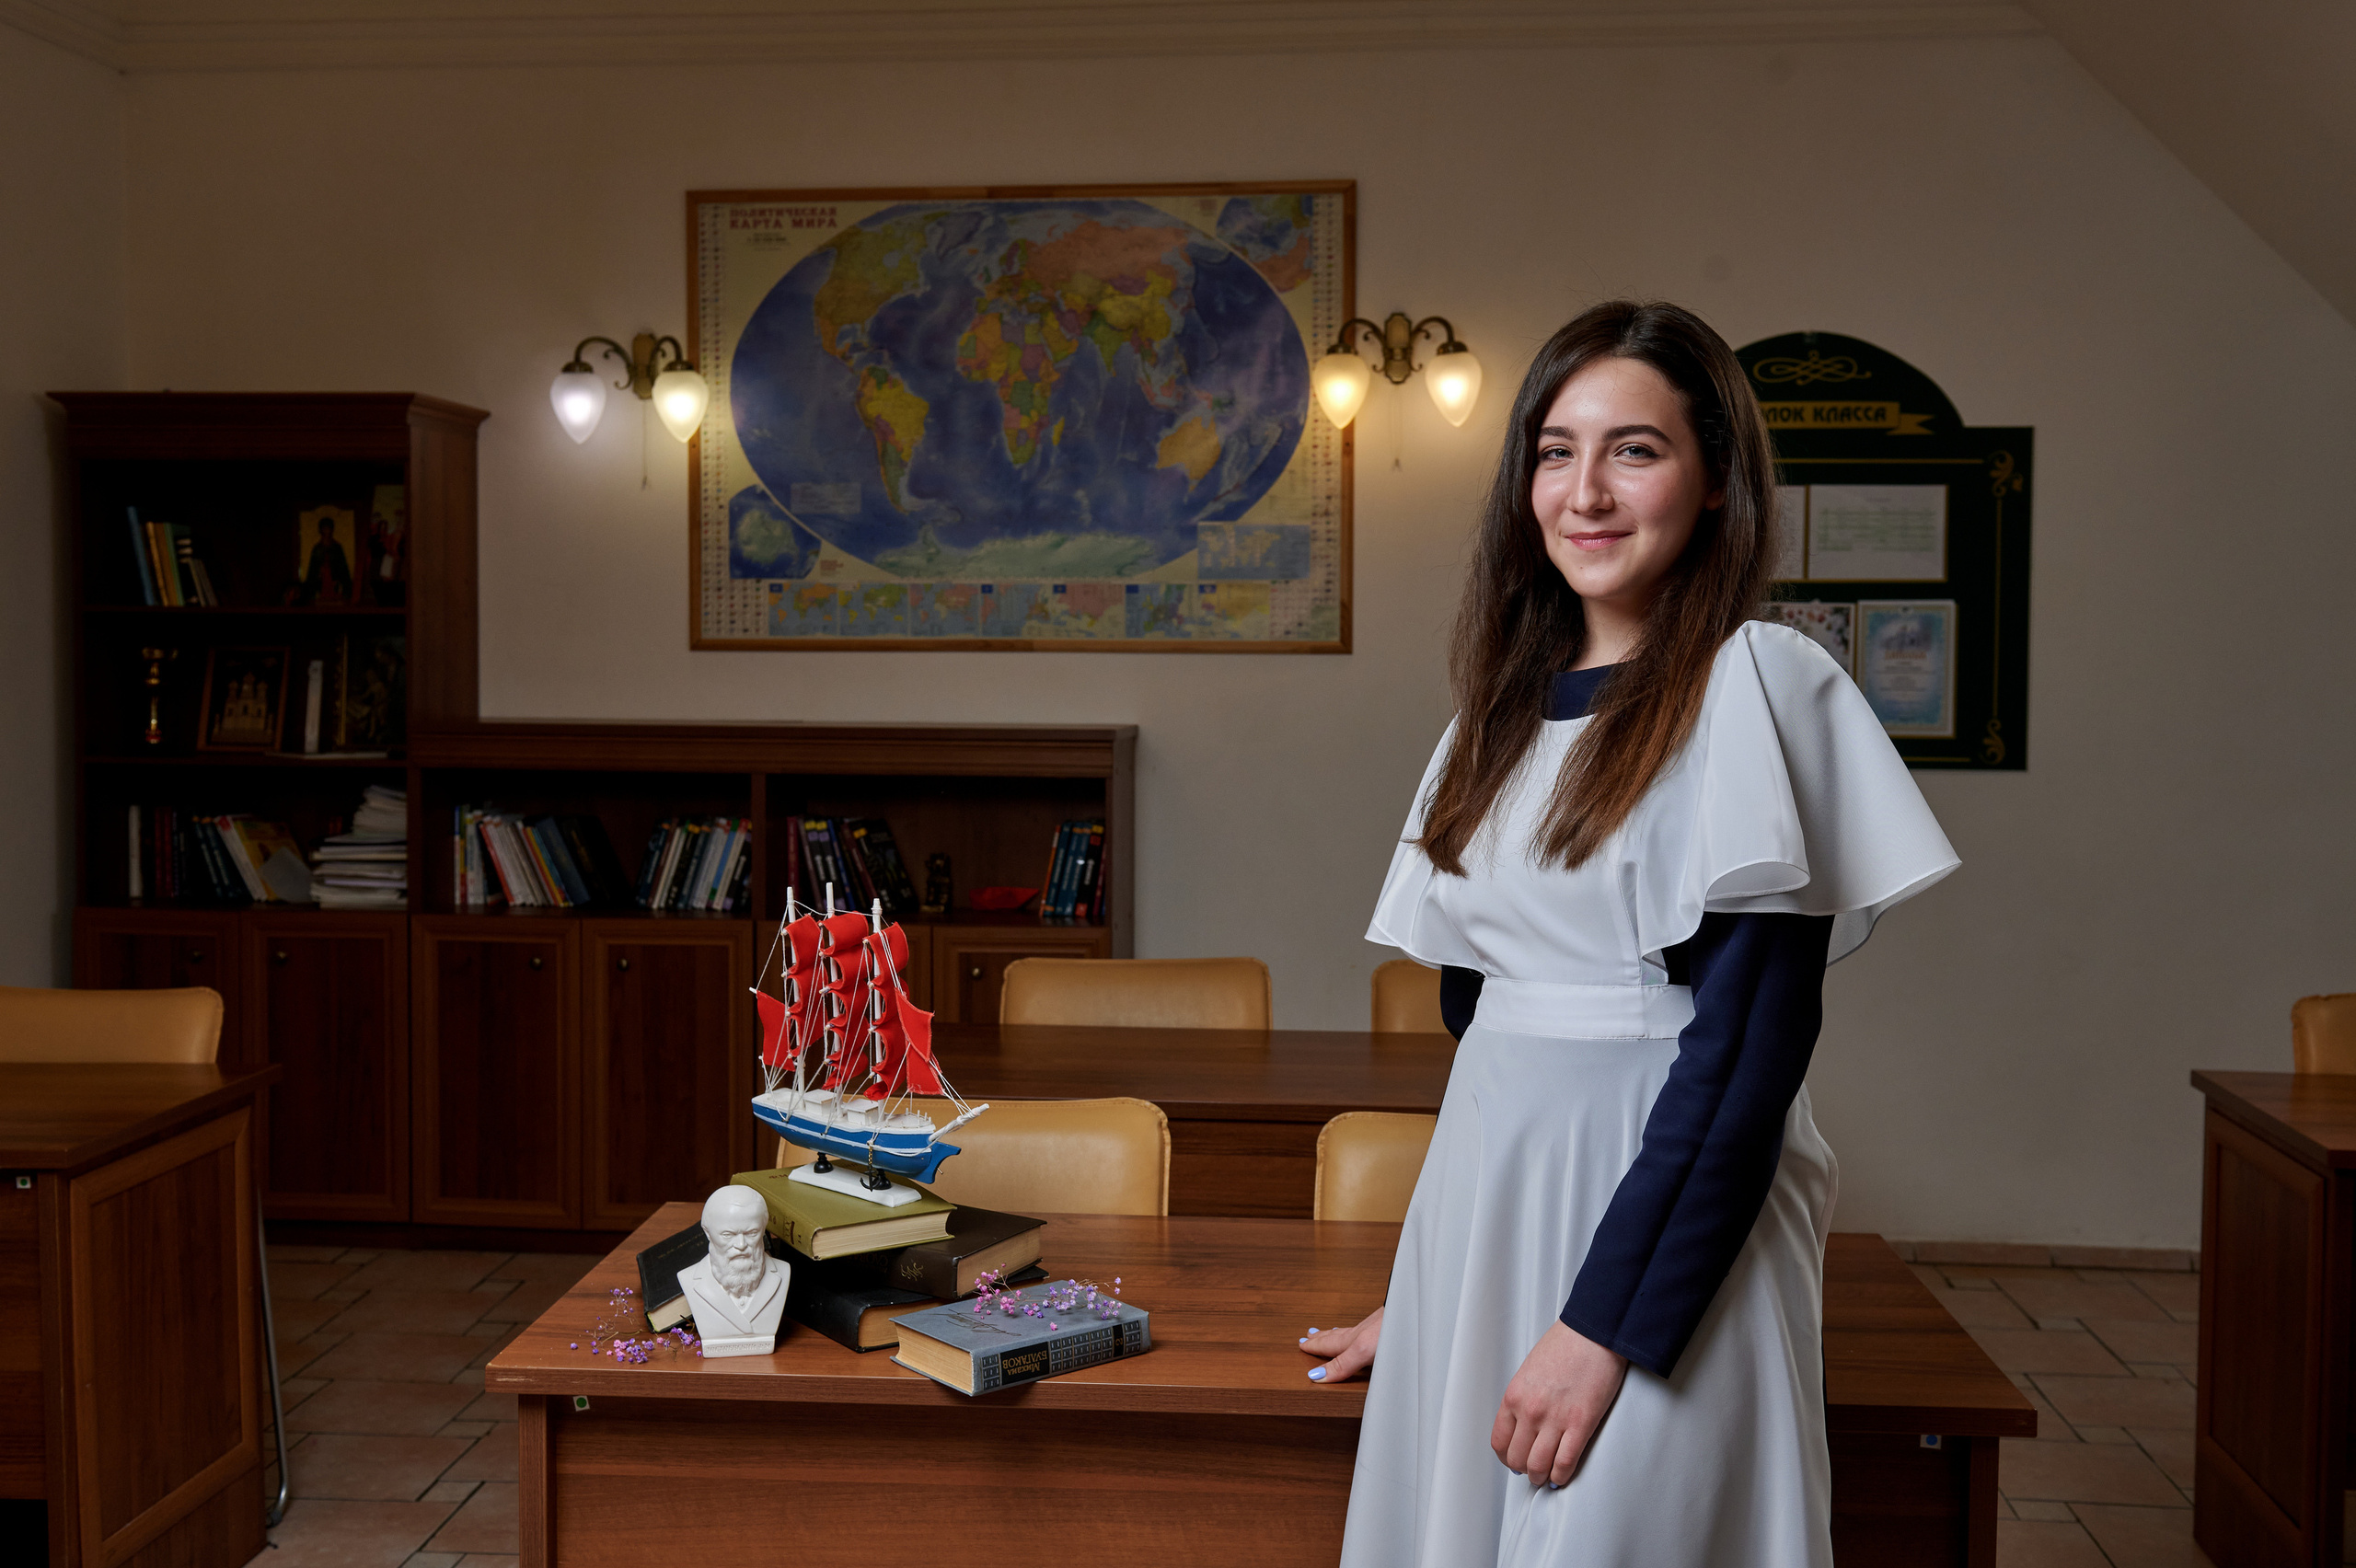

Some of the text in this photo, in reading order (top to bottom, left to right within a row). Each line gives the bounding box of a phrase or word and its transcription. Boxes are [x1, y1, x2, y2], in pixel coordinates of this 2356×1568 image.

[730, 207, 837, 217] ПОЛИТИЧЕСКАЯ
[730, 217, 837, 229] КАРТА МИРА
[1761, 407, 1886, 422] ЛОК КЛАССА
[1002, 1350, 1047, 1369] БУЛГАКОВ
[1007, 1362, 1040, 1376] Михаил
